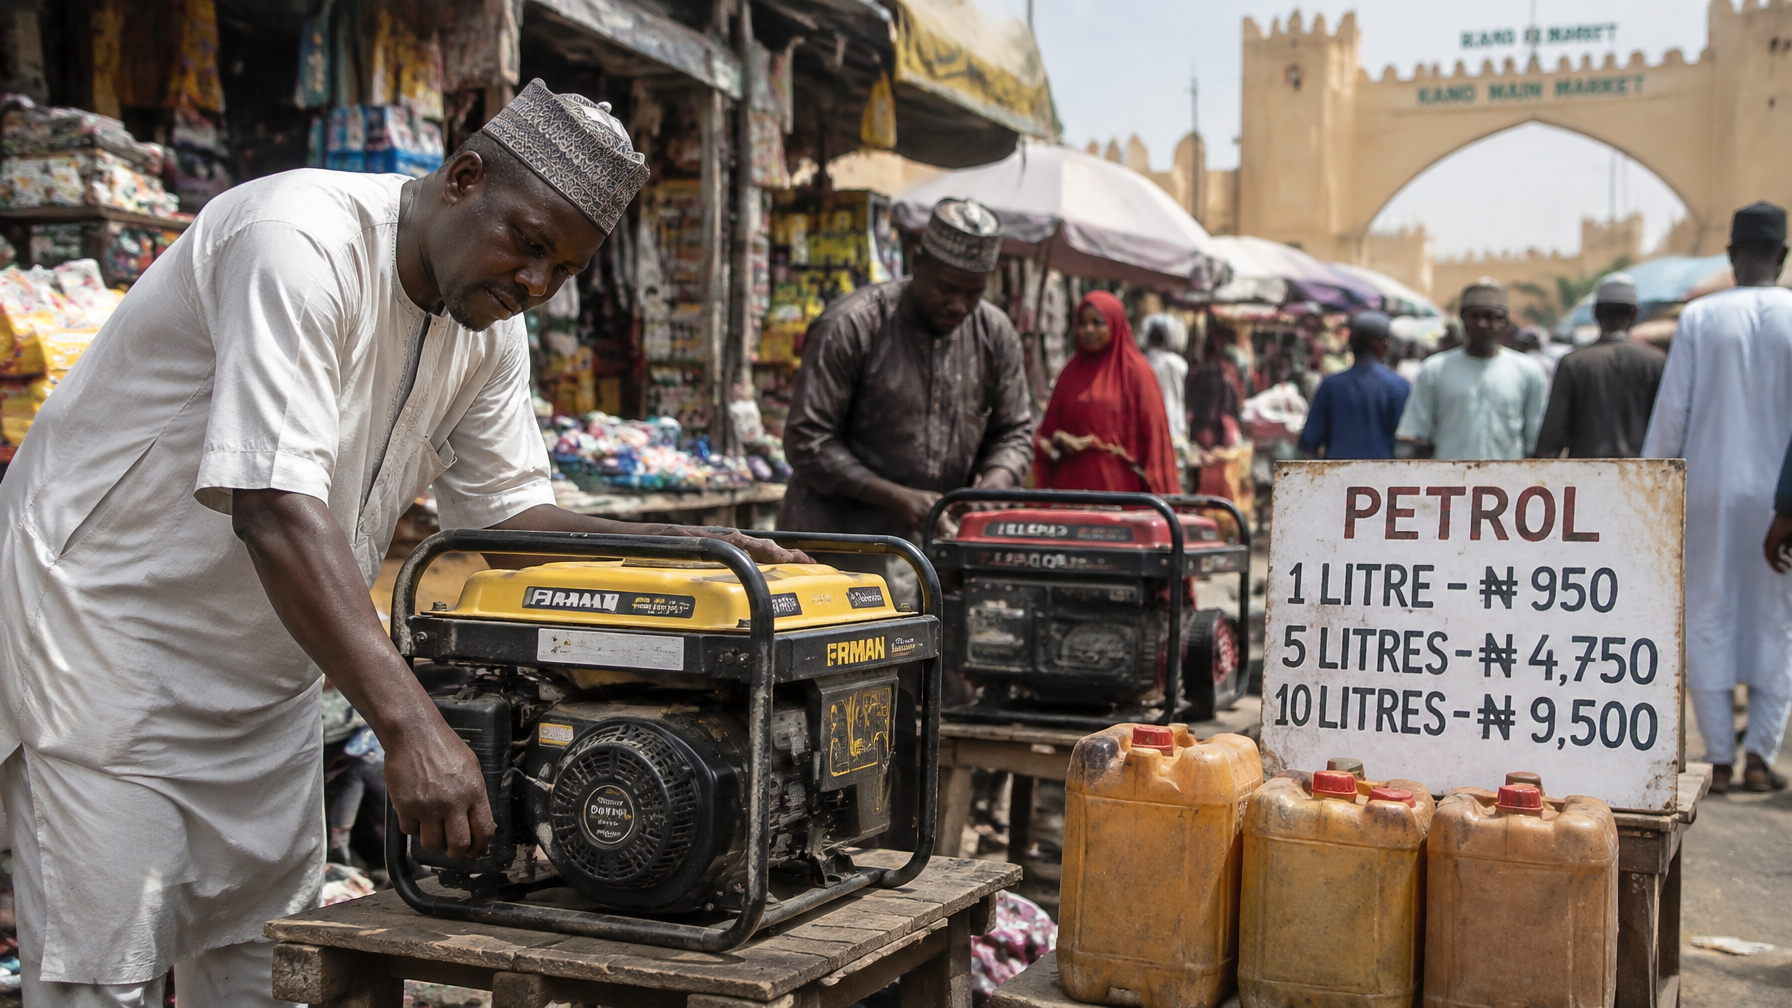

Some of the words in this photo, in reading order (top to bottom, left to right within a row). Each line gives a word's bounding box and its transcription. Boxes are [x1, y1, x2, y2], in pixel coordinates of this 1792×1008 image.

[1344, 486, 1599, 542] PETROL
[1288, 563, 1305, 604] 1
[1531, 566, 1618, 613] 950
[1282, 625, 1306, 668] 5
[1529, 635, 1658, 686] 4,750
[1531, 697, 1658, 751] 9,500
